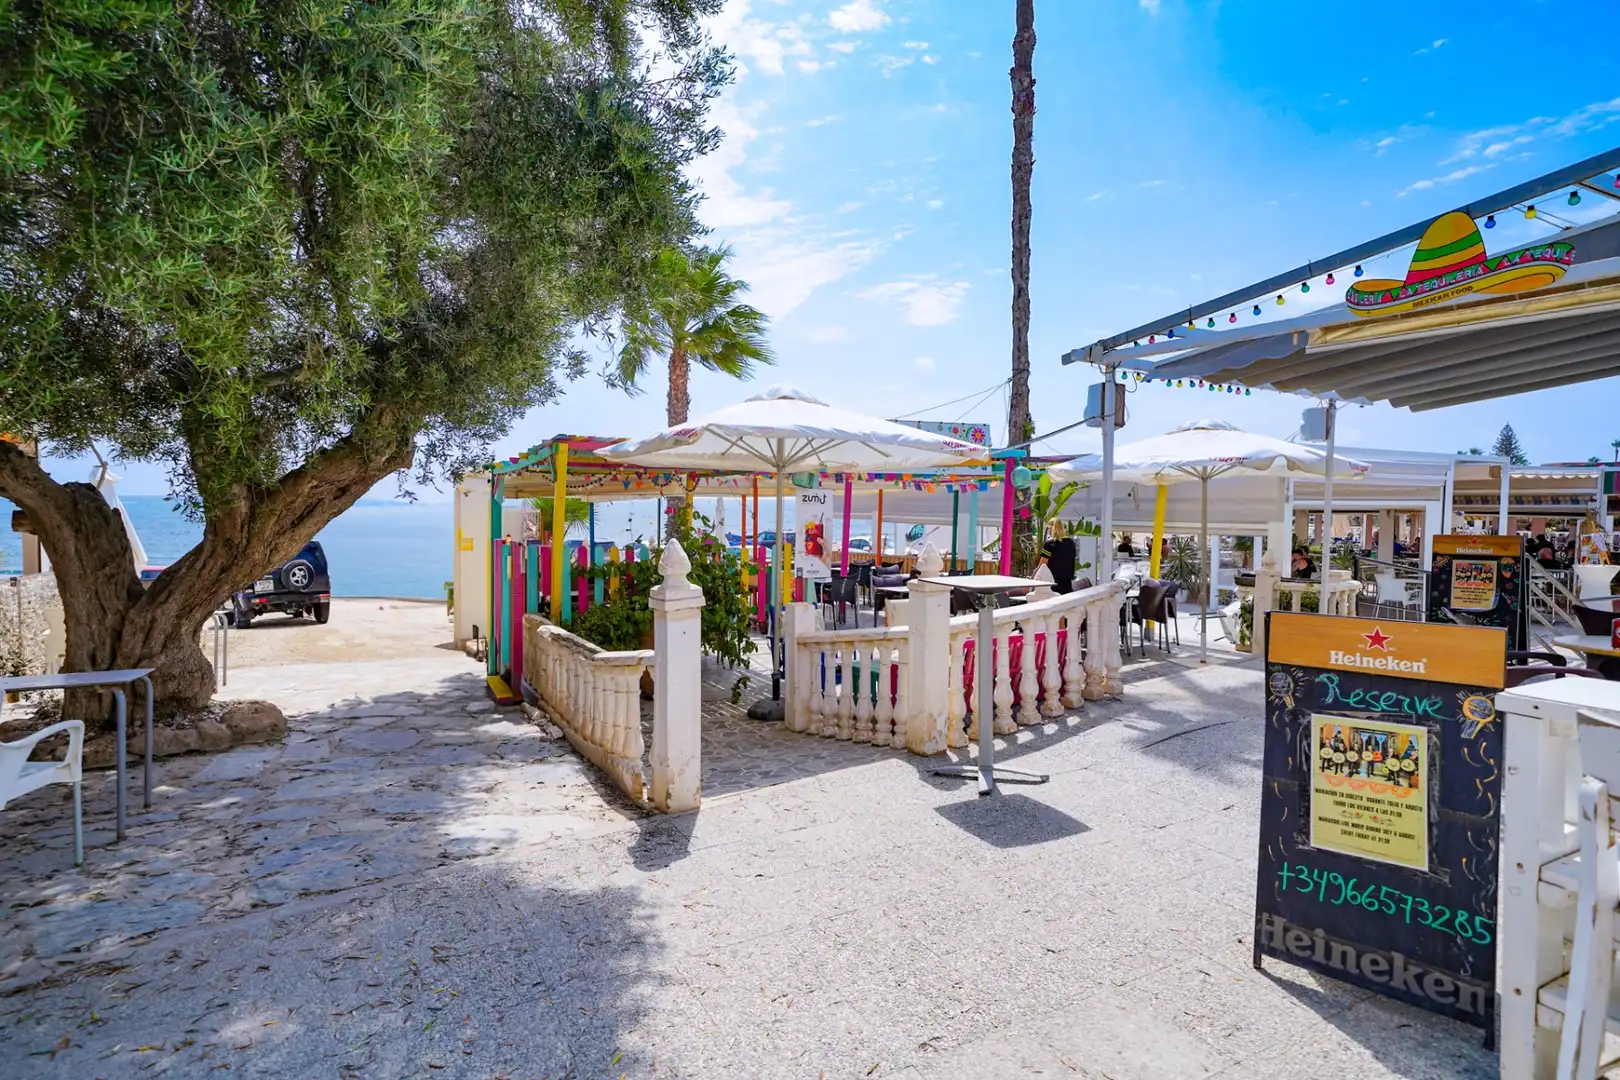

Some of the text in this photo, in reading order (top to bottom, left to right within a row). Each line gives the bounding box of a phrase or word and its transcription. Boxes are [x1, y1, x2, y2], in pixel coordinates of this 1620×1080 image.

[1412, 285, 1474, 308] MEXICAN FOOD
[1329, 650, 1425, 674] Heineken
[1314, 672, 1456, 721] Reserve
[1277, 861, 1495, 945] +34966573285
[1260, 911, 1487, 1016] Heineken
